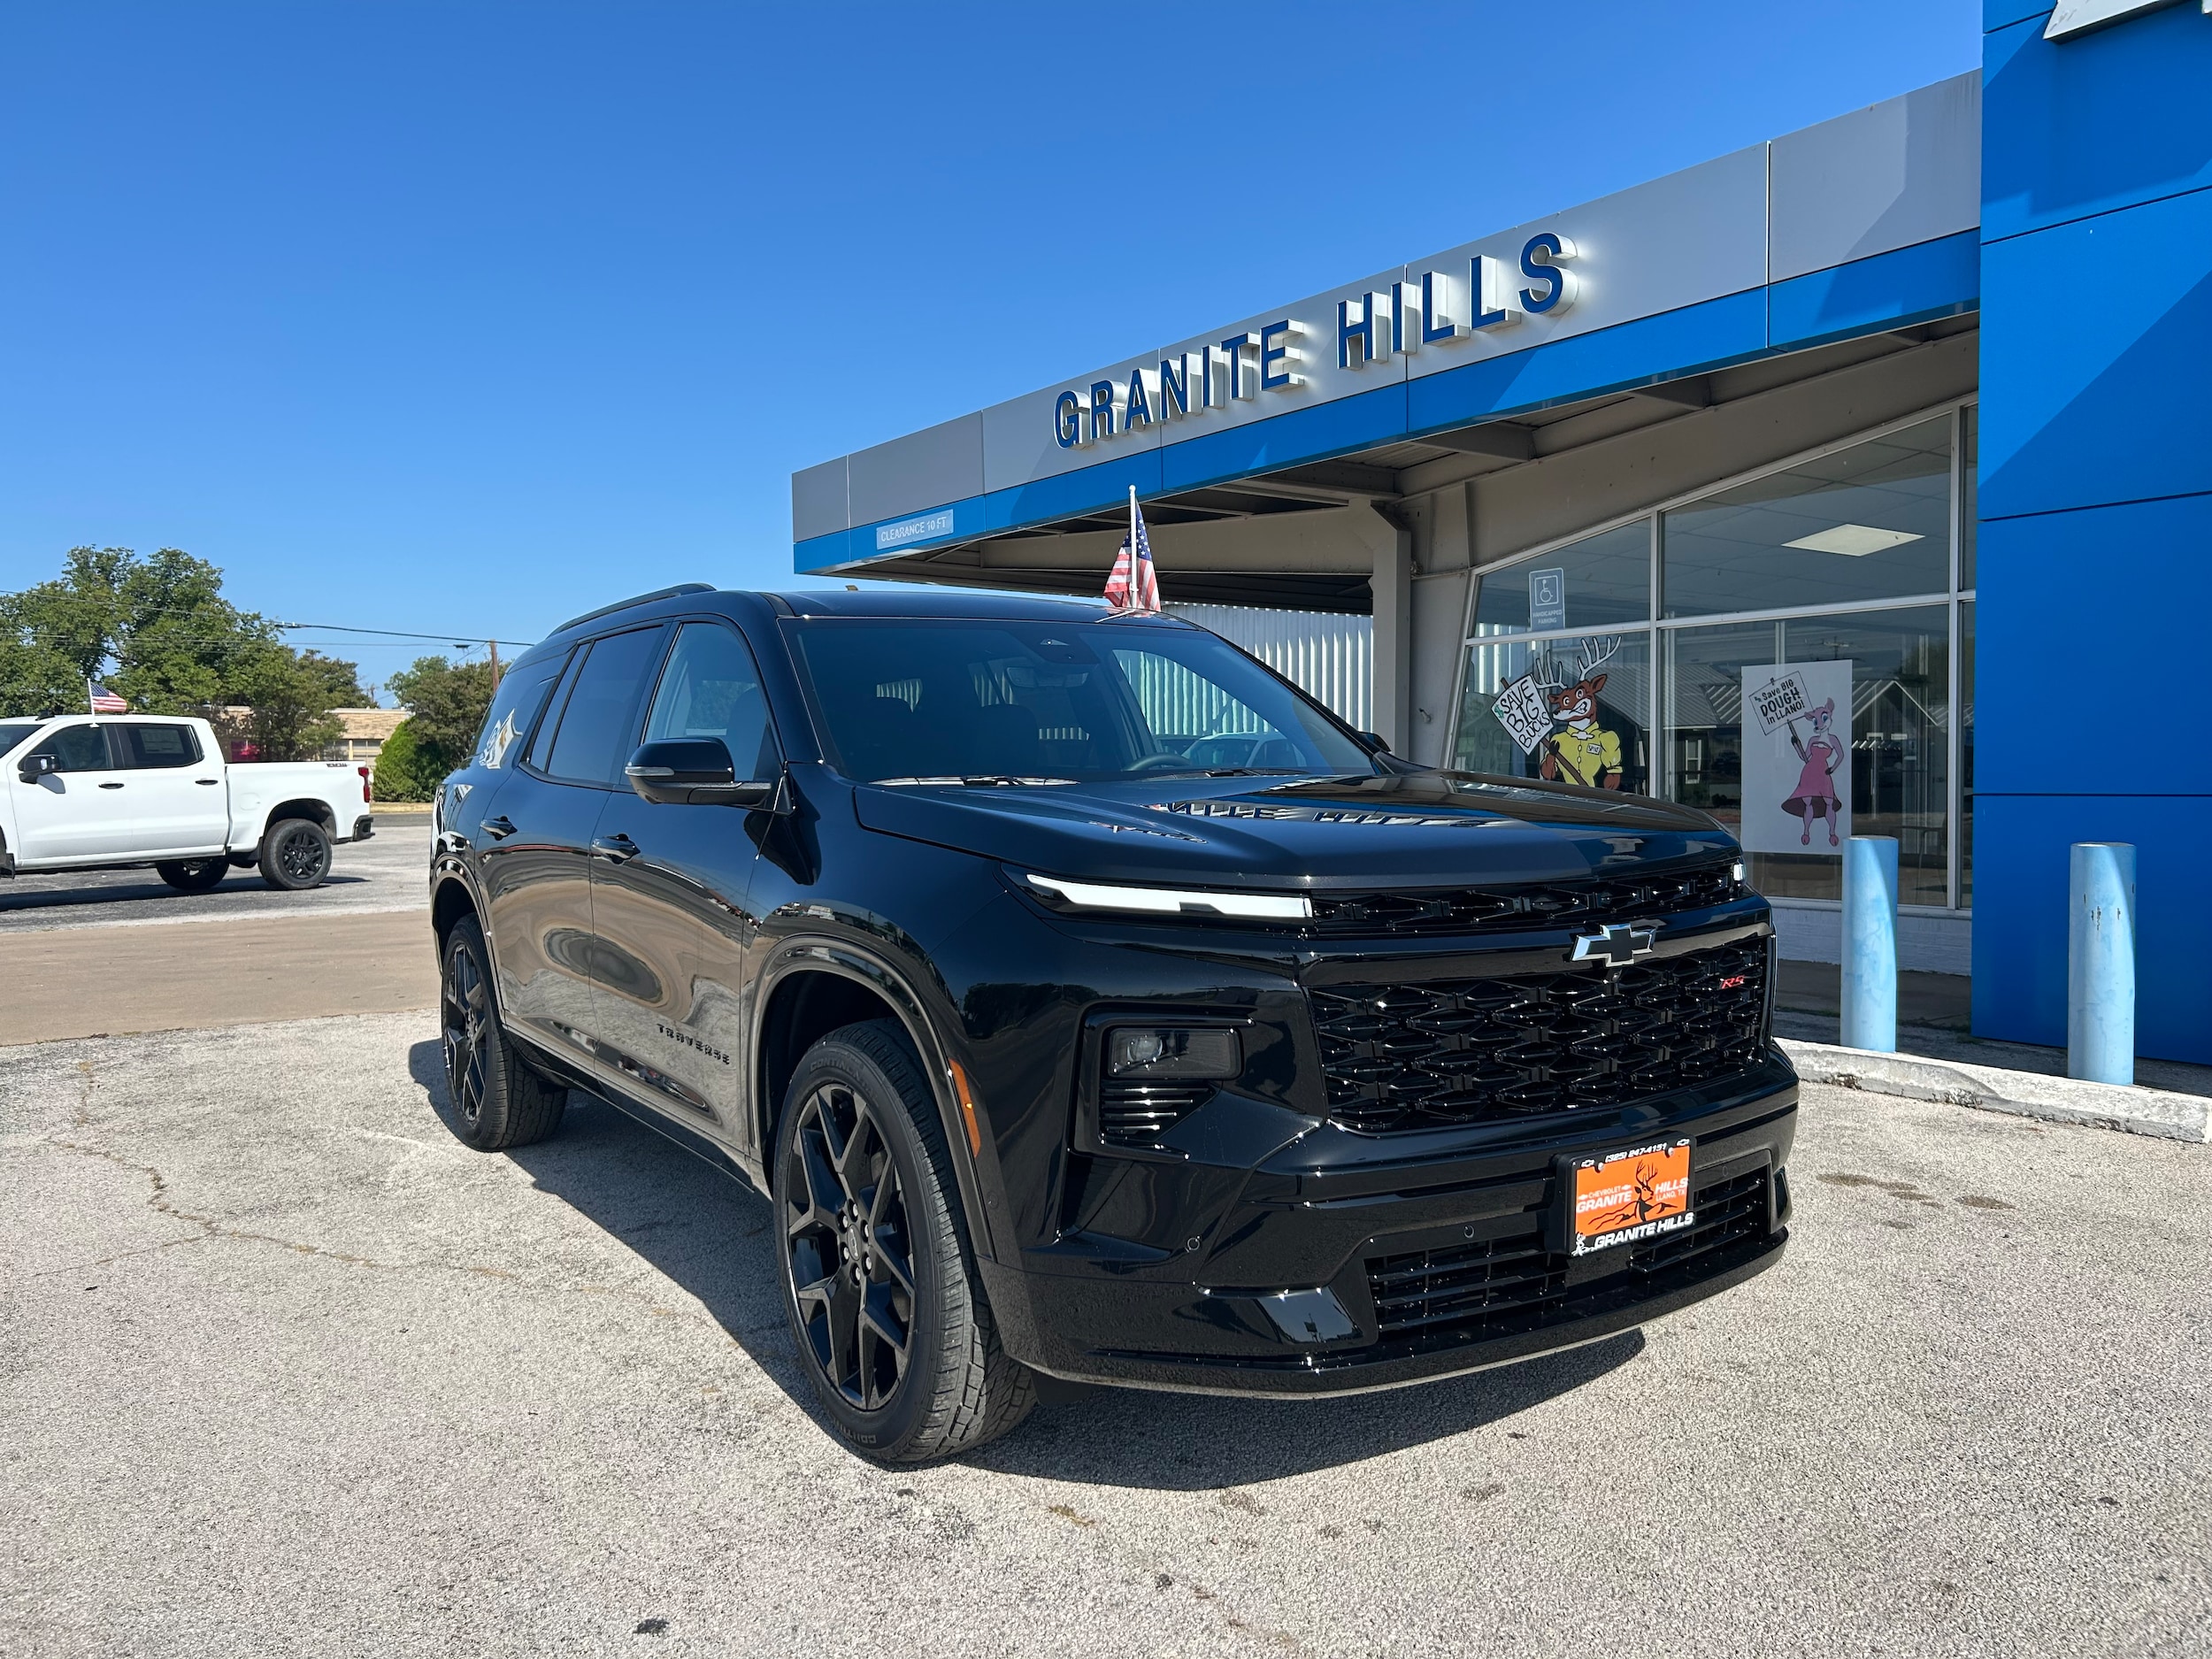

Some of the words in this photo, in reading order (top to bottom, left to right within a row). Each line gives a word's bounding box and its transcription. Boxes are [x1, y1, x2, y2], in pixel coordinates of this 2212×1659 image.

[1055, 319, 1304, 449] GRANITE
[1337, 232, 1578, 370] HILLS
[880, 522, 925, 541] CLEARANCE
[926, 520, 935, 531] 10
[937, 517, 947, 529] FT
[1501, 680, 1534, 714] SAVE
[1760, 687, 1801, 717] DOUGH
[1762, 687, 1781, 701] Save
[1780, 679, 1794, 691] BIG
[1506, 698, 1540, 733] BIG
[1775, 700, 1805, 721] LLANO!
[1518, 711, 1551, 749] BUCKS
[1721, 974, 1745, 989] RS
[657, 1024, 730, 1064] TRAVERSE
[1605, 1152, 1627, 1163] (325)
[1628, 1142, 1667, 1157] 247-4151
[1588, 1186, 1621, 1199] CHEVROLET
[1655, 1177, 1688, 1194] HILLS
[1576, 1190, 1632, 1213] GRANITE
[1594, 1222, 1656, 1248] GRANITE
[1657, 1212, 1694, 1233] HILLS
